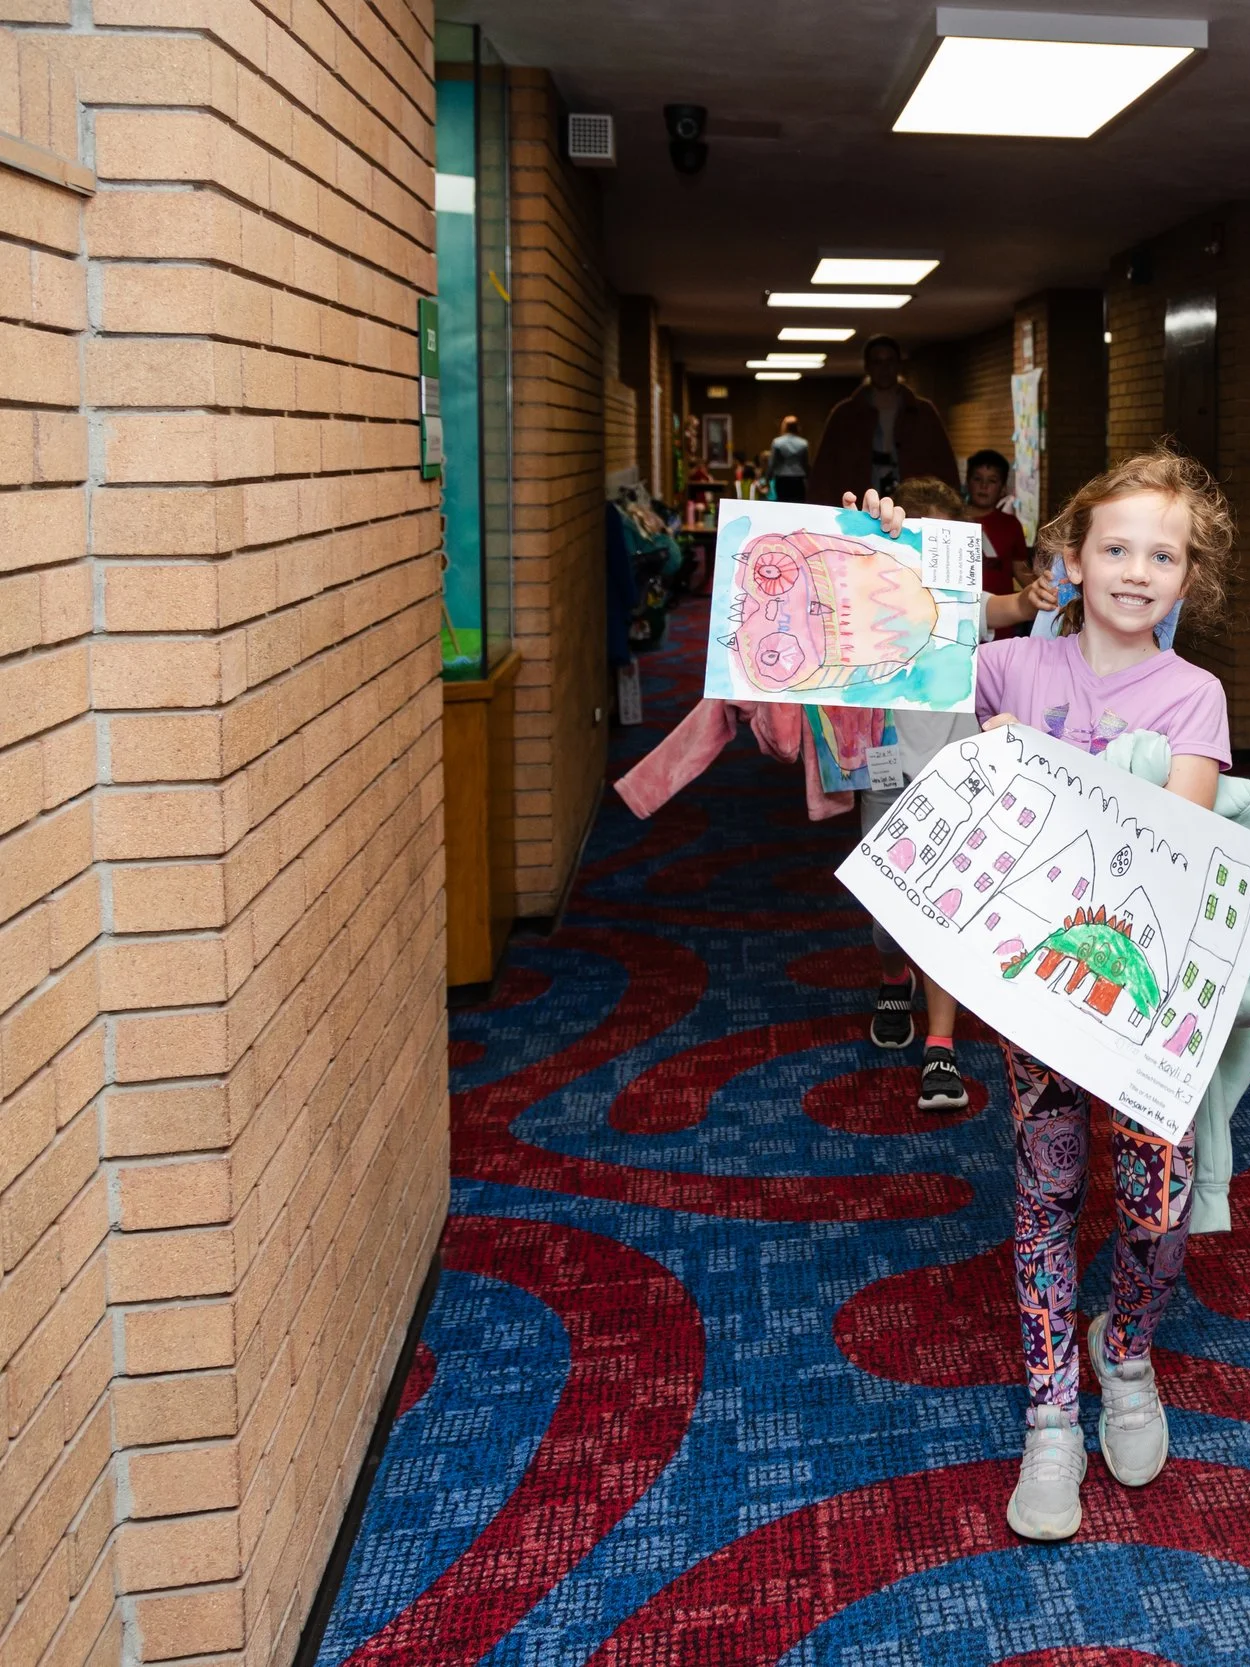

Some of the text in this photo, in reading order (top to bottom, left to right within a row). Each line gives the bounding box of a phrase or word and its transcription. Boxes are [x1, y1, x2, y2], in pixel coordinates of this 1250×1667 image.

[928, 547, 940, 568] Kayli
[967, 565, 976, 586] Warm
[1143, 1053, 1158, 1066] Name
[1157, 1057, 1181, 1081] Kayli
[1174, 1089, 1194, 1105] K-J
[1118, 1091, 1147, 1113] Dinosaur
[1146, 1107, 1154, 1117] in
[1153, 1110, 1165, 1125] the
